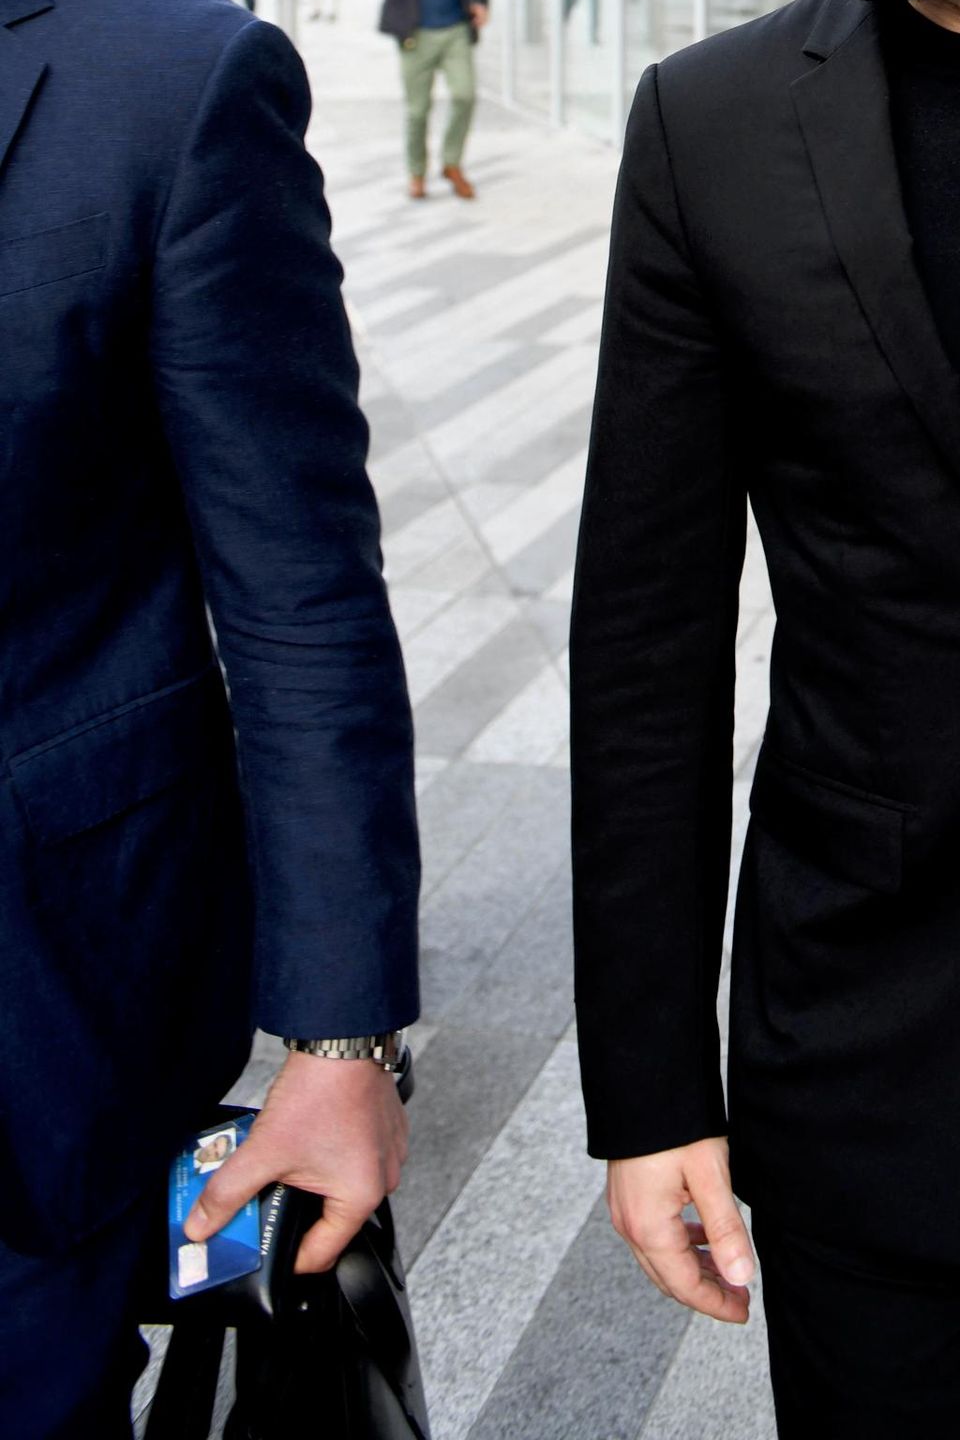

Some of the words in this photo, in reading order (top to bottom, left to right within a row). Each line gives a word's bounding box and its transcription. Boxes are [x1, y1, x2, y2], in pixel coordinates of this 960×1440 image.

[271, 1183, 286, 1206] PIQU
[267, 1208, 278, 1222] DE
[260, 1224, 274, 1255] VALET
